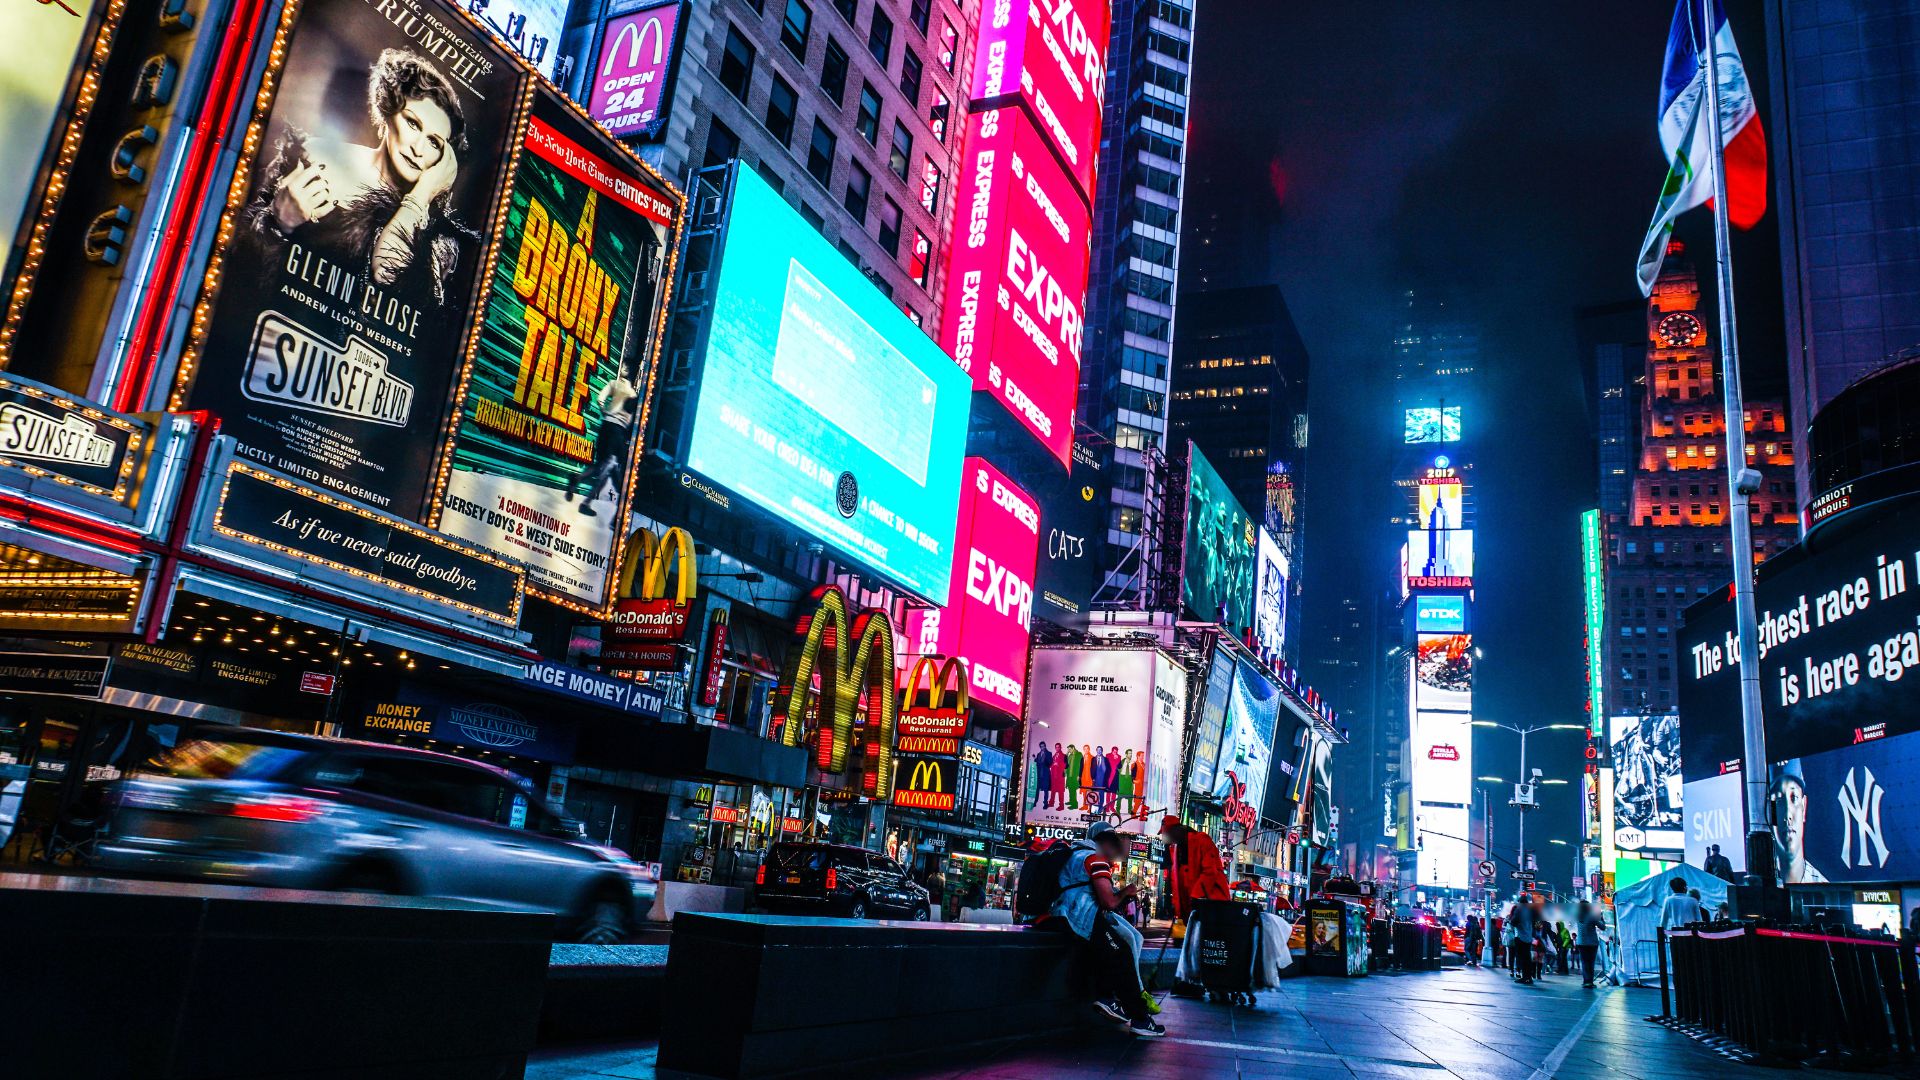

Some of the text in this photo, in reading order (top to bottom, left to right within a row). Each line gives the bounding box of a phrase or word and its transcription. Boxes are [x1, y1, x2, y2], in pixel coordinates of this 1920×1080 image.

[364, 0, 481, 84] RIUMPH!
[424, 13, 495, 76] mesmerizing,
[603, 71, 656, 92] OPEN
[604, 87, 646, 115] 24
[601, 110, 654, 130] OURS
[526, 121, 544, 144] The
[544, 133, 565, 157] New
[565, 147, 587, 173] York
[587, 160, 614, 188] Times
[614, 177, 652, 209] CRITICS'
[967, 149, 996, 250] EXPRESS
[1026, 172, 1071, 244] EXPRESS
[576, 187, 598, 256] A
[286, 243, 423, 340] GLENN CLOSE
[512, 195, 620, 358] BRONX
[280, 284, 412, 358] ANDREW LLOYD WEBBER'S
[348, 306, 360, 317] in
[1012, 300, 1059, 367] EXPRESS
[265, 331, 408, 422] SUNSET BLVD.
[512, 303, 598, 435] TALE
[1004, 377, 1052, 438] EXPRESS
[6, 413, 83, 460] SUNSET
[290, 412, 355, 445] SUNSET BOULEVARD
[296, 426, 362, 458] ANDREW LLOYD WEBBER
[474, 395, 595, 463] BROADWAY'S NEW HIT MUSICAL
[281, 426, 297, 439] DON
[296, 430, 316, 445] BLACK
[320, 439, 359, 463] CHRISTOPHER
[358, 455, 386, 472] HAMPTON
[307, 444, 344, 464] BILLY WILDER
[307, 450, 346, 471] LONNY PRICE
[236, 442, 392, 508] RICTLY LIMITED ENGAGEMENT
[1420, 477, 1462, 485] TOSHIBA
[1427, 468, 1456, 479] 2017
[860, 495, 870, 510] A
[894, 517, 906, 534] TO
[991, 479, 1040, 535] EXPRESS
[1812, 484, 1854, 511] MARRIOTT
[1813, 498, 1850, 523] MARQUIS
[444, 494, 488, 523] JERSEY
[486, 512, 516, 536] BOYS
[514, 522, 525, 537] &
[525, 528, 557, 553] WEST
[554, 536, 576, 557] SIDE
[575, 547, 608, 571] STORY.
[505, 500, 572, 538] COMBINATION OF
[273, 508, 478, 592] As if we never said goodbye.
[1048, 527, 1086, 562] CATS
[1586, 514, 1597, 574] VOTED
[1408, 576, 1474, 588] TOSHIBA
[1429, 608, 1462, 619] TDK
[1589, 576, 1600, 625] BEST
[1692, 640, 1723, 680] The
[1725, 594, 1810, 667] toghest
[1814, 576, 1871, 628] race
[1876, 554, 1907, 601] in
[610, 611, 685, 626] McDonald's
[615, 625, 669, 636] Restaurant
[211, 660, 280, 681] STRICTLY LIMITED
[602, 650, 673, 662] OPEN 24 HOURS
[1593, 626, 1603, 689] BEACH
[217, 669, 271, 686] ENGAGEMENT
[568, 673, 626, 704] MONEY
[631, 692, 662, 713] ATM
[972, 662, 1022, 706] EXPRESS
[1049, 682, 1059, 691] IT
[1060, 684, 1087, 695] SHOULD
[1088, 685, 1099, 695] BE
[1078, 676, 1116, 685] MUCH FUN
[1780, 665, 1801, 707] is
[1804, 652, 1860, 699] here
[364, 715, 433, 735] EXCHANGE
[376, 702, 423, 719] MONEY
[448, 710, 538, 740] MONEY EXCHANGE
[899, 715, 965, 728] McDonald's
[909, 726, 953, 735] Restaurant
[1862, 722, 1887, 736] MARRIOTT
[1863, 730, 1885, 744] MARQUIS
[1223, 770, 1258, 846] Disney
[1693, 807, 1732, 843] SKIN
[1837, 765, 1891, 870] NY
[1618, 832, 1642, 844] CMT
[1862, 891, 1891, 903] INVICTA
[1312, 910, 1341, 922] Beautiful
[1202, 948, 1229, 959] SQUARE
[1203, 939, 1227, 949] TIMES
